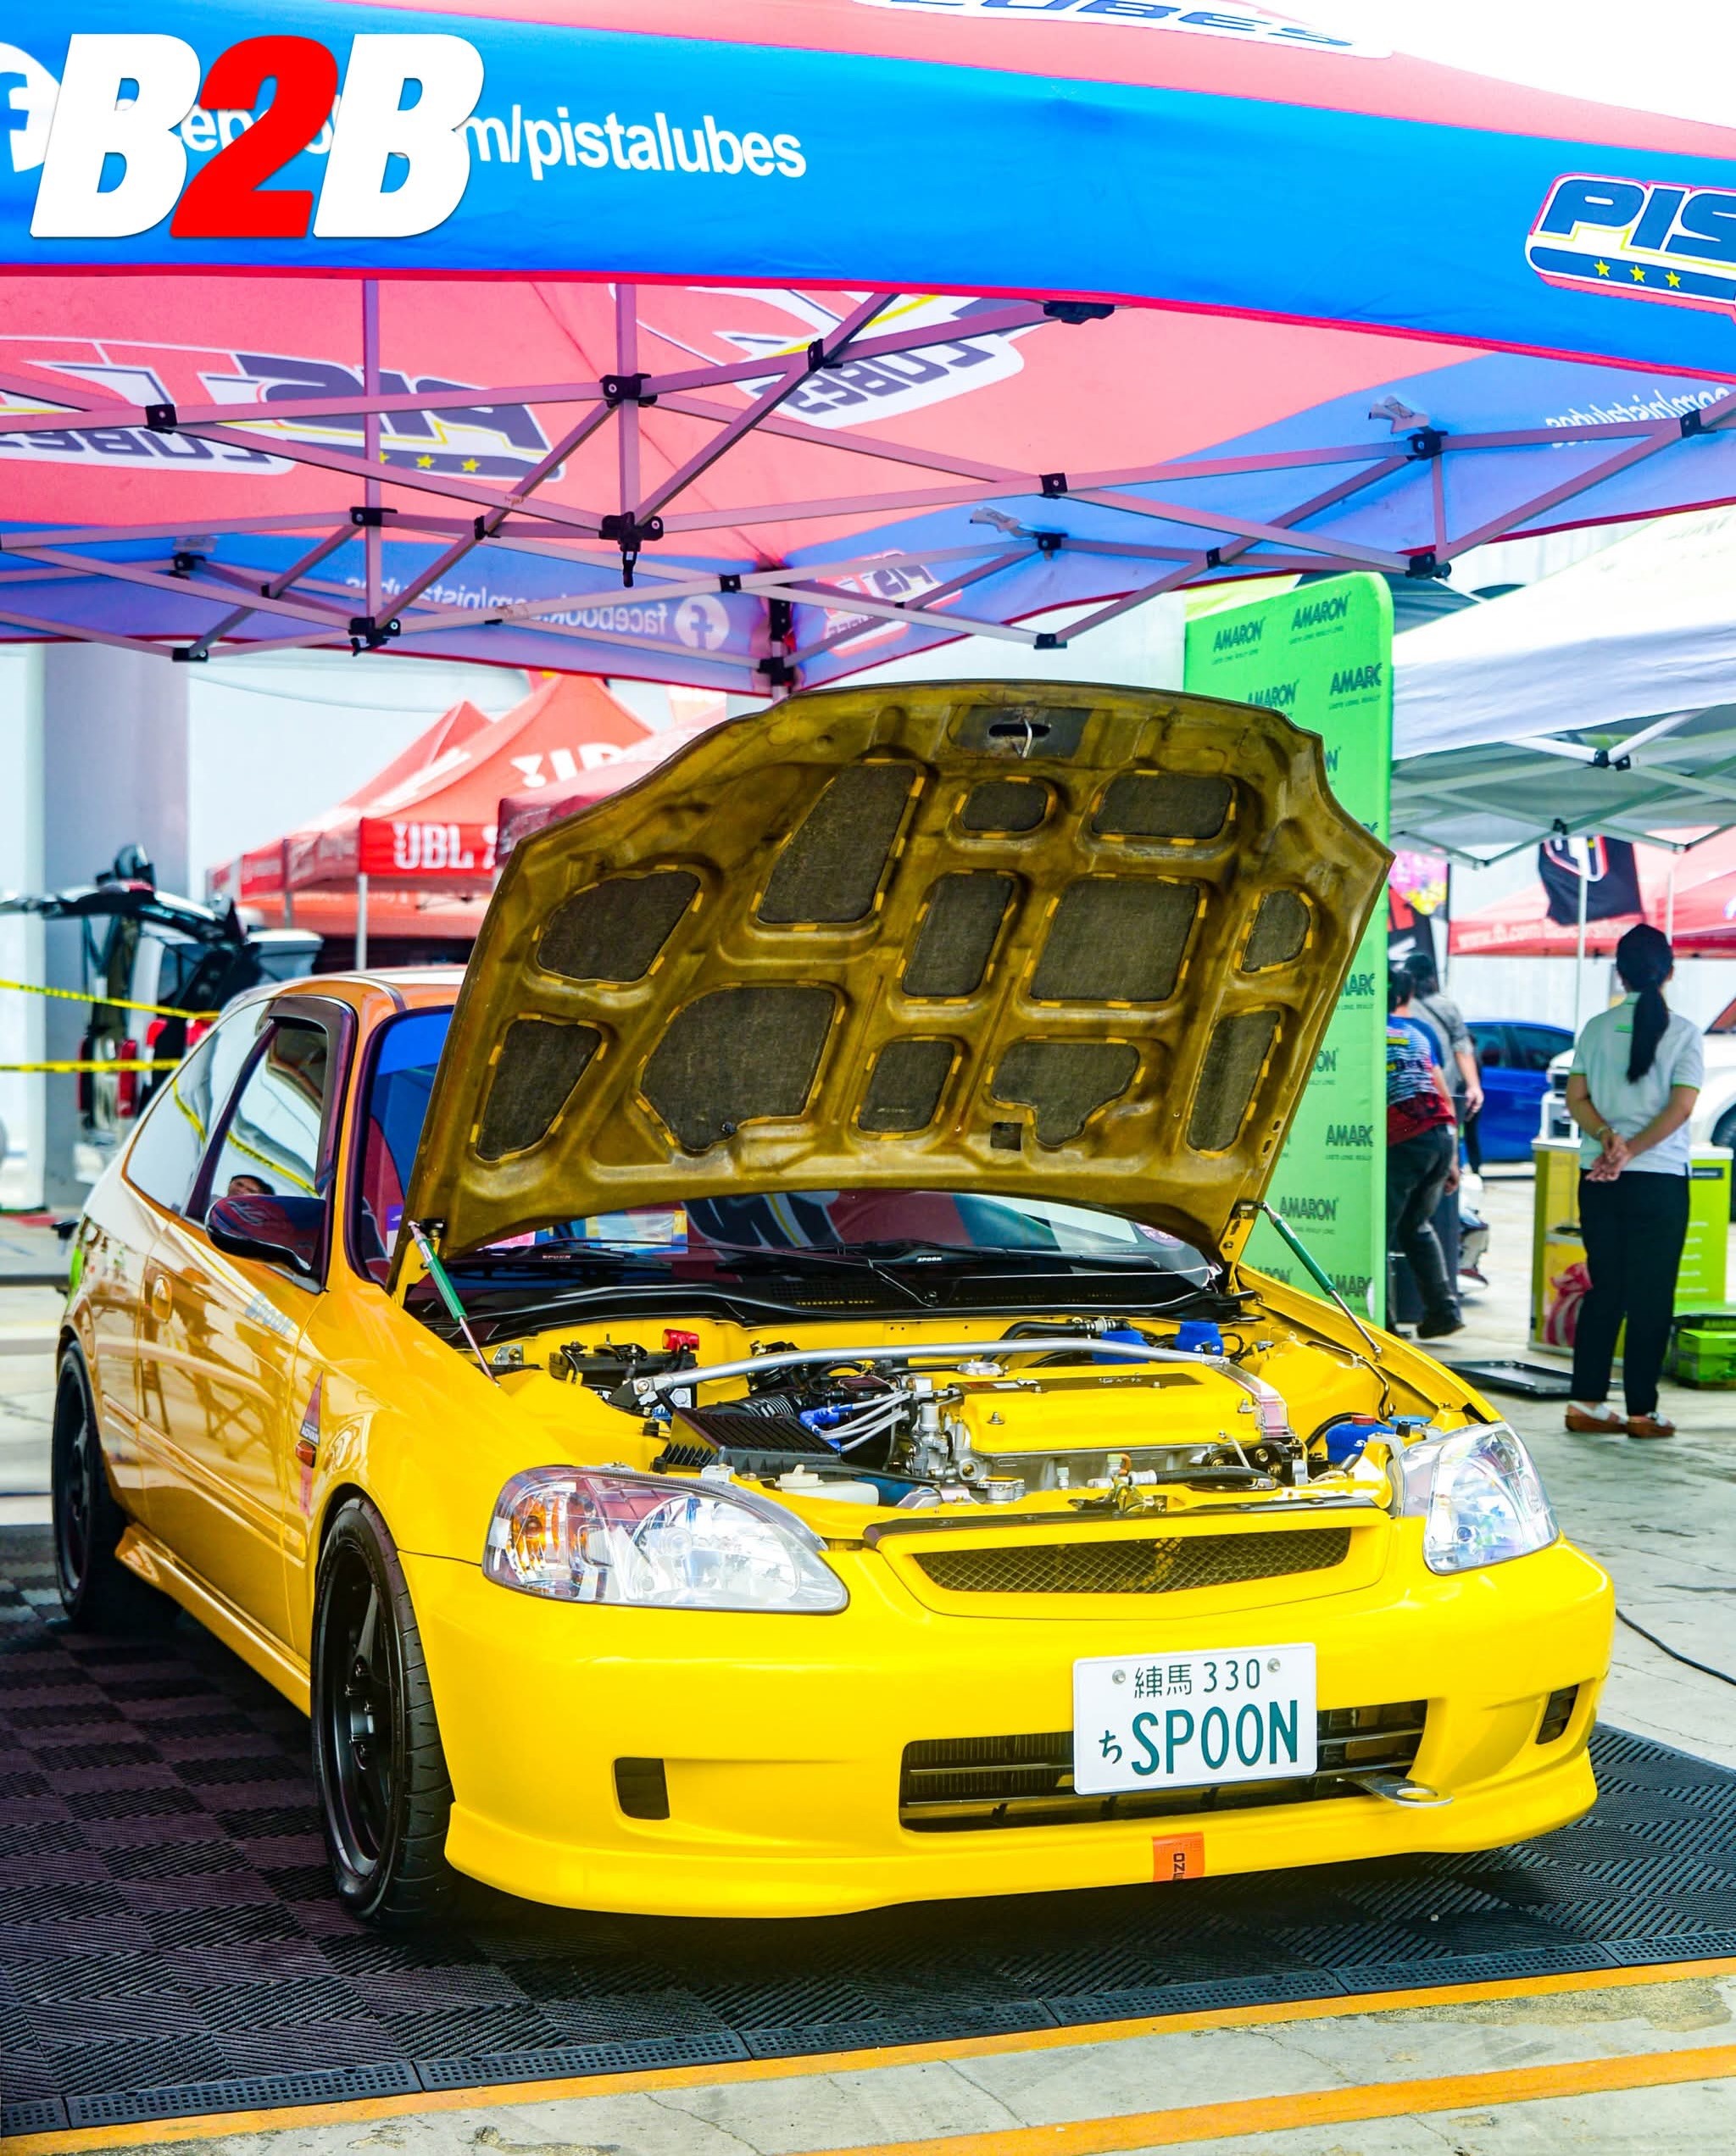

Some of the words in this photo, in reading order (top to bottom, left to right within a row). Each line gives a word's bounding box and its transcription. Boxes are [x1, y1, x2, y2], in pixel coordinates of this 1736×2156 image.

[1292, 596, 1349, 631] AMARON
[1213, 620, 1263, 653] AMARON
[1279, 1196, 1337, 1221] AMARON
[1134, 1664, 1193, 1698] 練馬
[1203, 1659, 1260, 1693] 330
[1098, 1730, 1123, 1764] ち
[1131, 1699, 1298, 1775] SPOON
